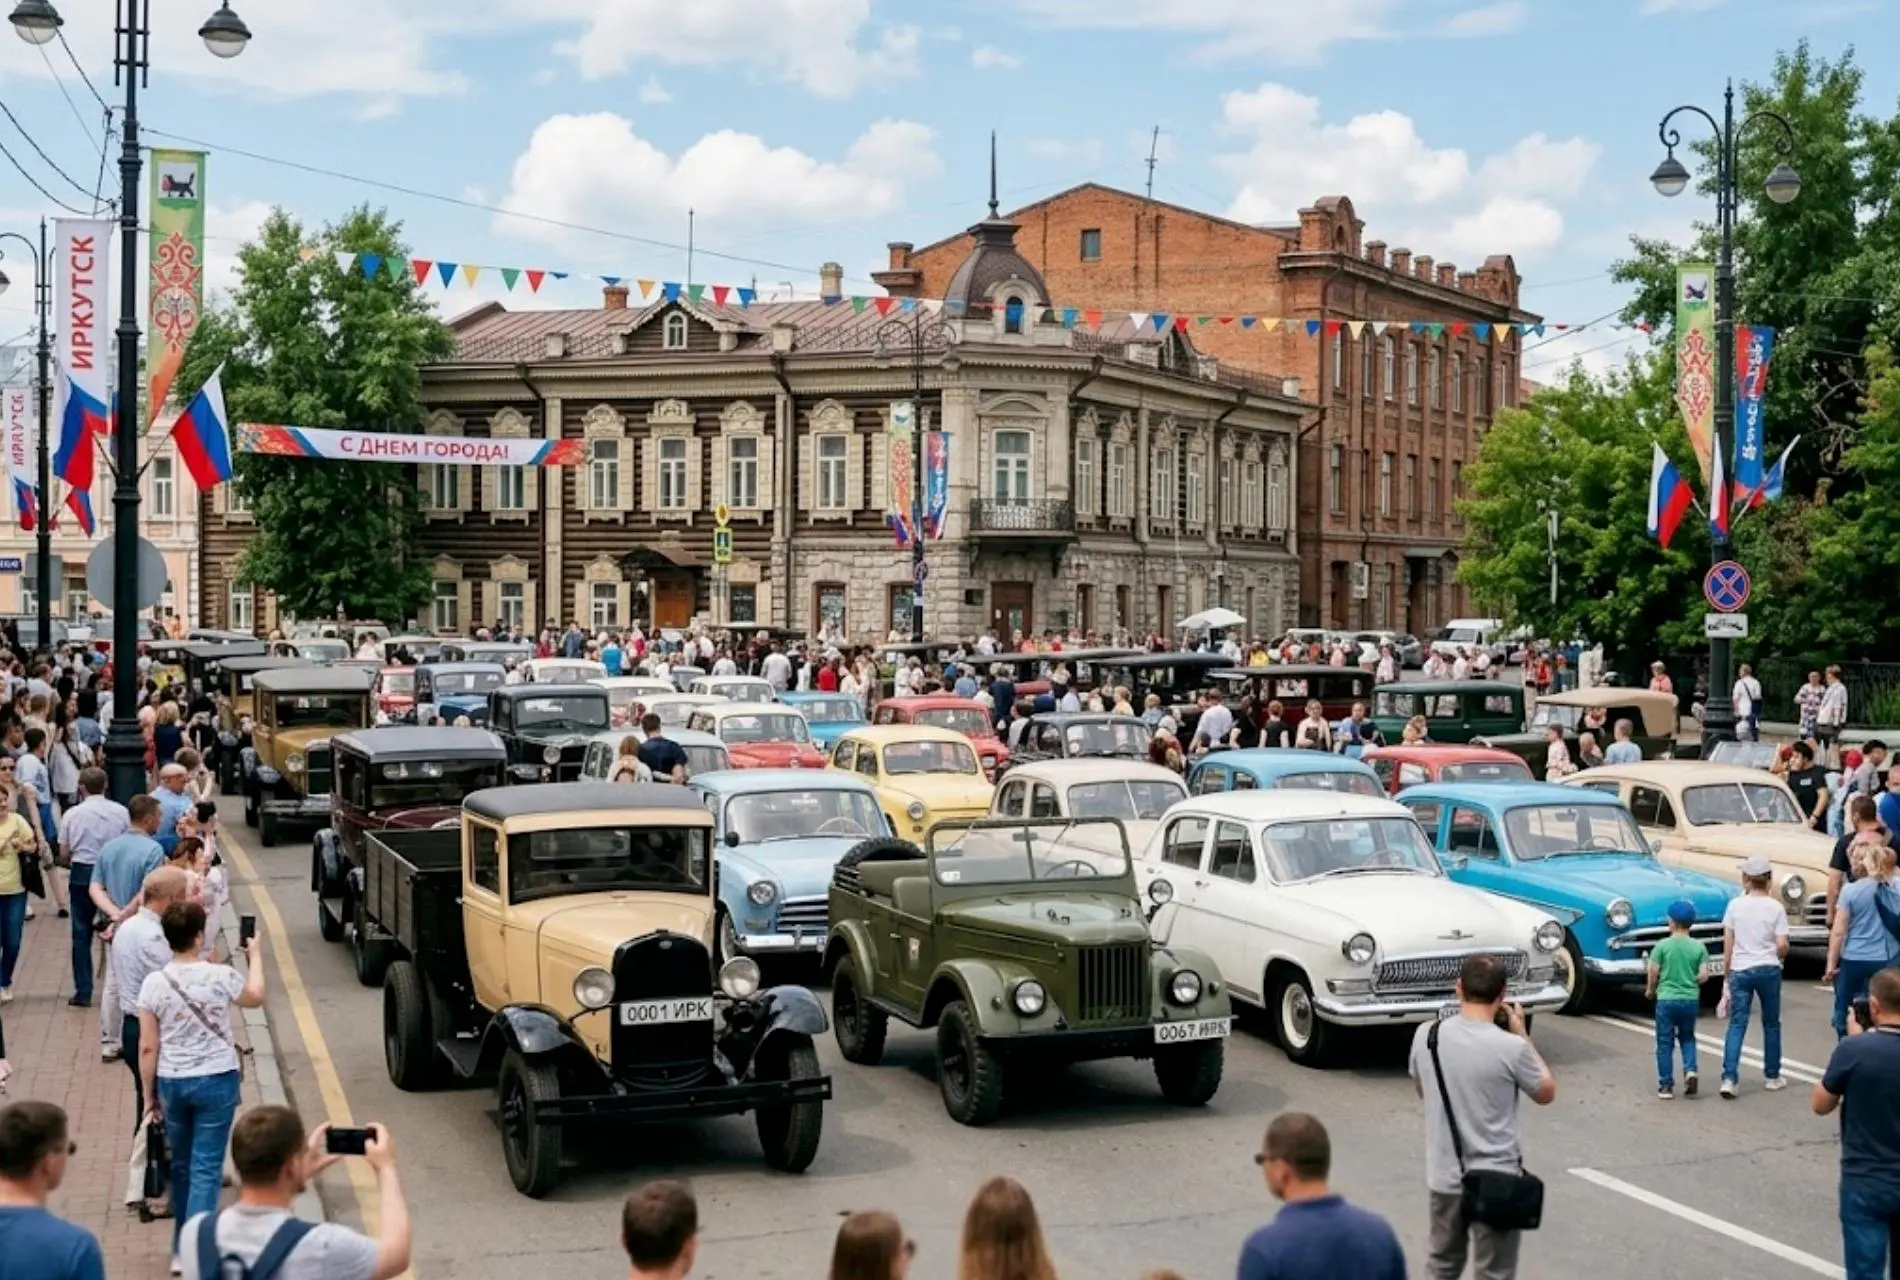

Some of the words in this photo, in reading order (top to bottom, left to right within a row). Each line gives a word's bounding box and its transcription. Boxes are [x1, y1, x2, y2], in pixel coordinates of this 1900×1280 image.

[71, 235, 94, 370] ИРКУТСК
[340, 436, 353, 453] С
[358, 437, 418, 456] ДНЕМ
[424, 441, 508, 462] ГОРОДА!
[627, 1004, 668, 1021] 0001
[673, 1001, 708, 1019] ИРК
[1160, 1023, 1196, 1040] 0067
